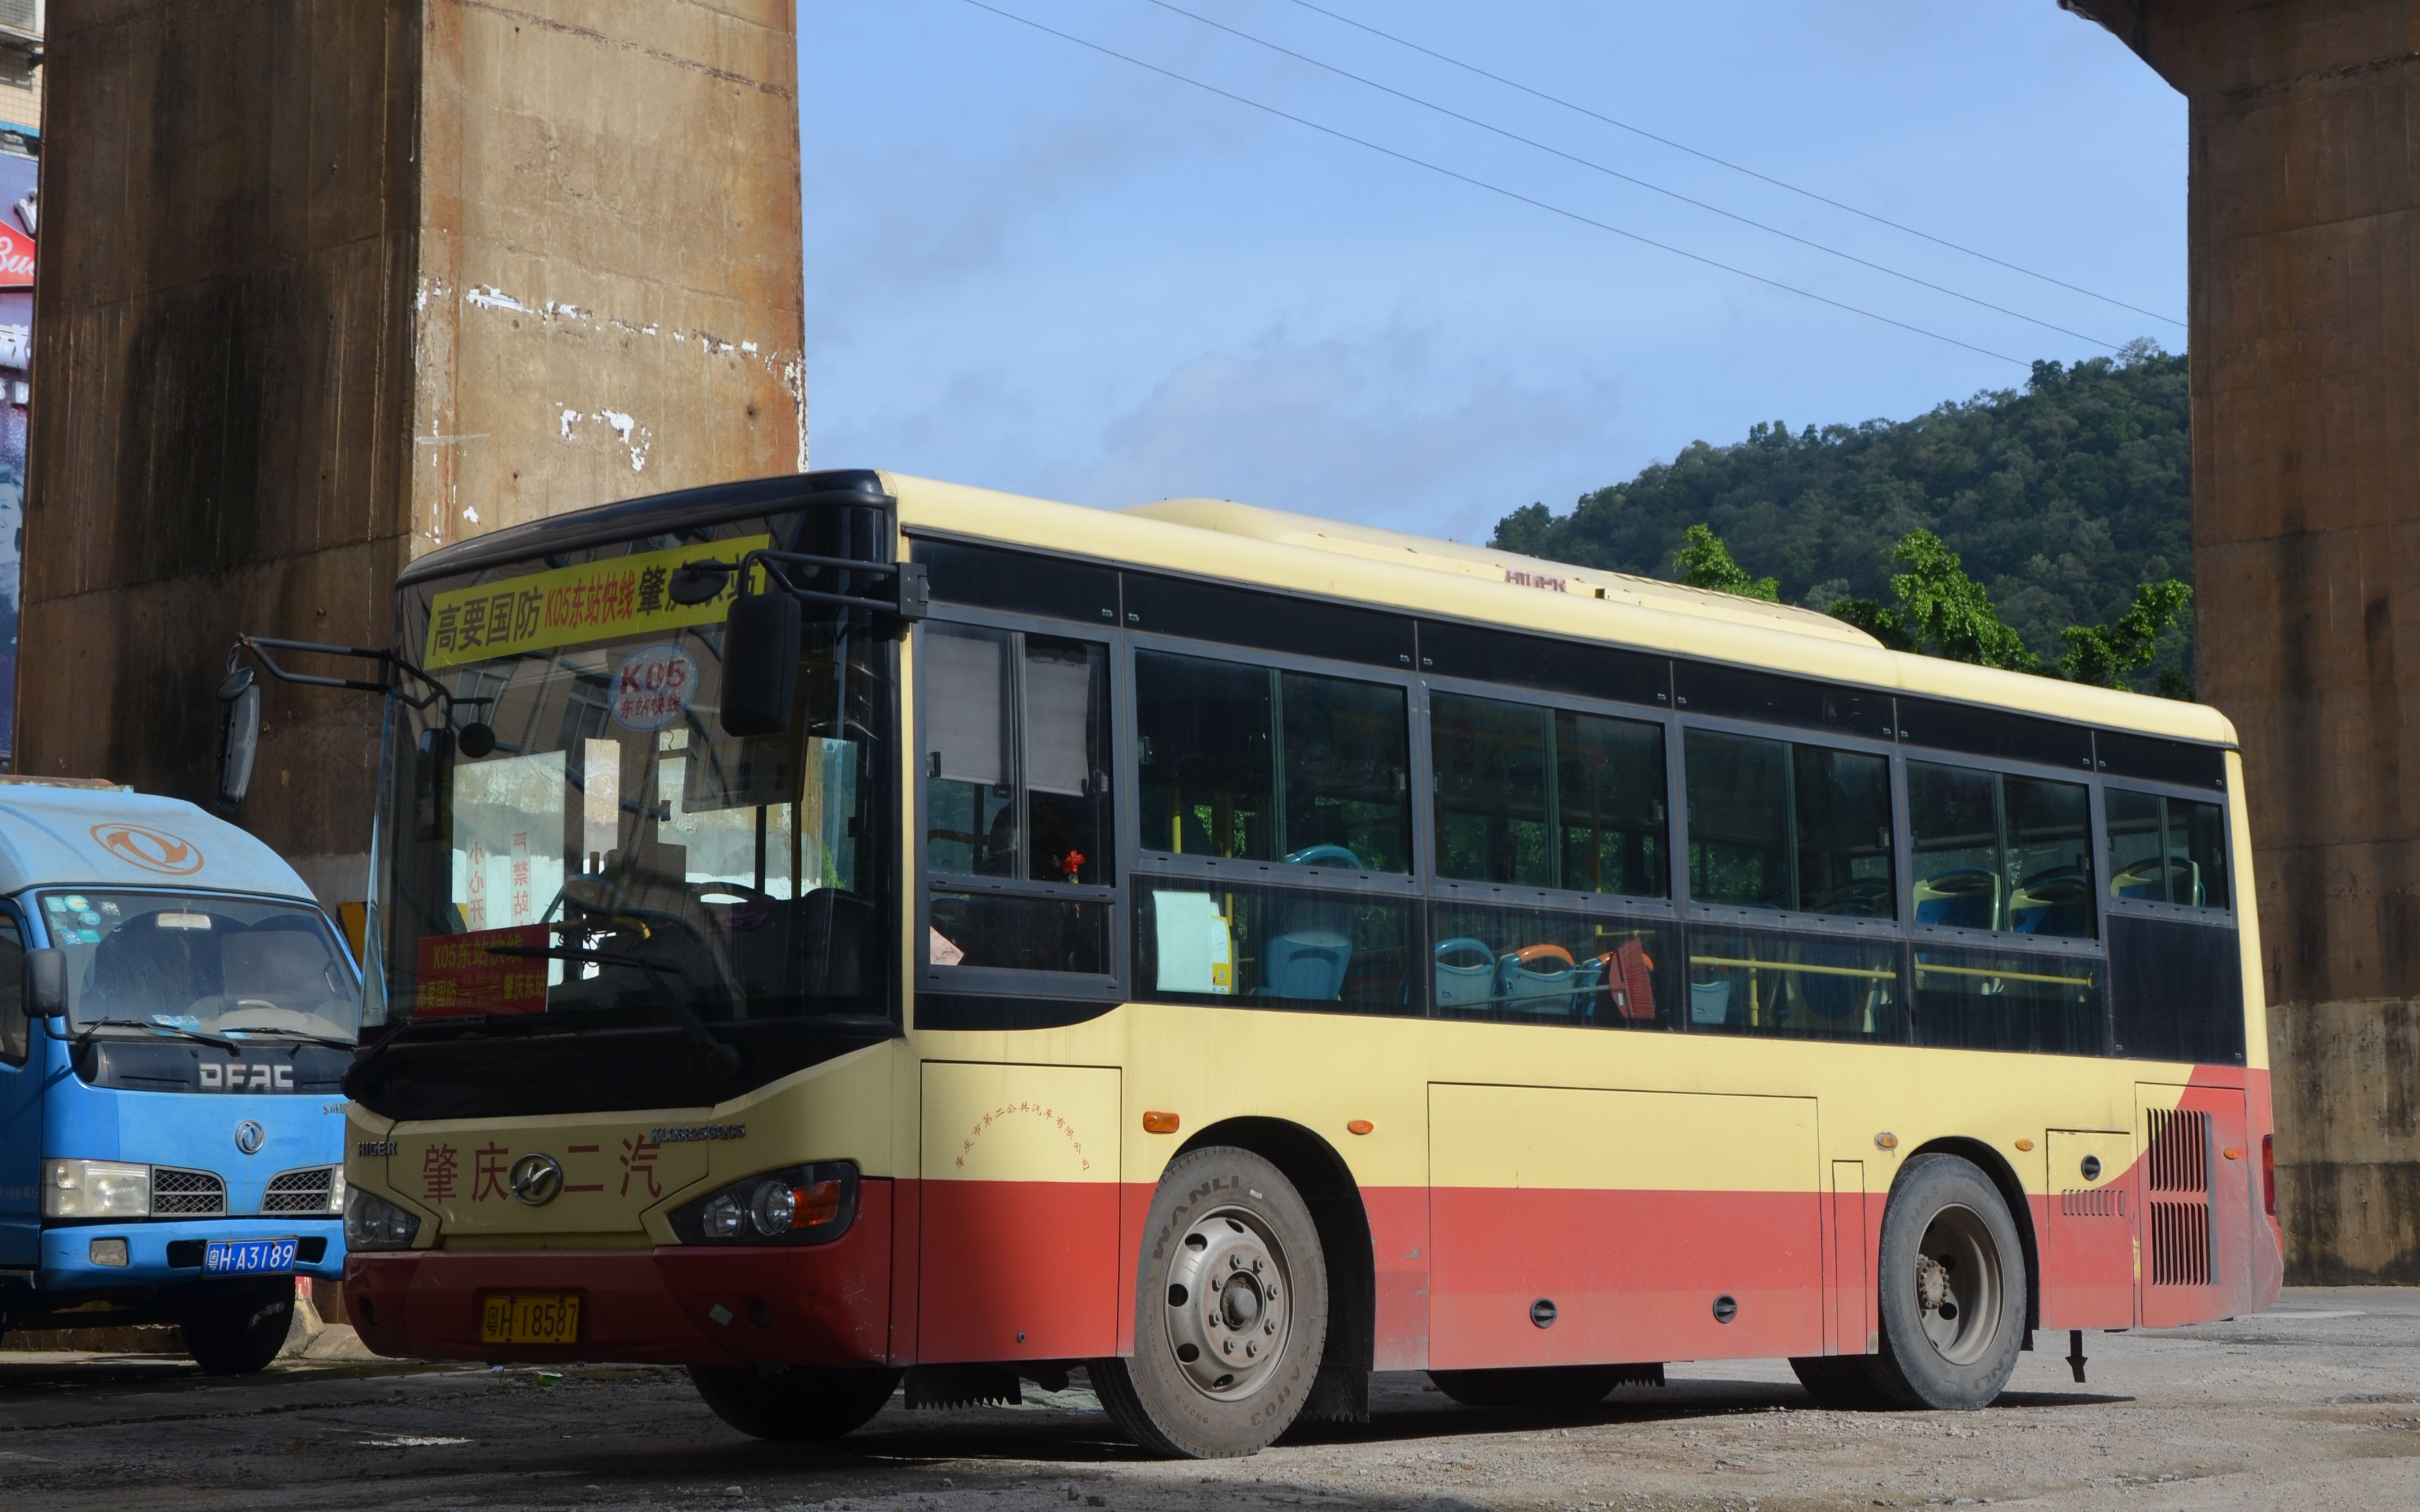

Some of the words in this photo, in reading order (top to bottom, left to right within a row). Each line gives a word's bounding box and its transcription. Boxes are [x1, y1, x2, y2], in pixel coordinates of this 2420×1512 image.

[432, 585, 543, 656] 高要国防
[544, 570, 635, 629] K05东站快线
[621, 659, 686, 694] K05
[621, 691, 681, 720] 东站快线
[417, 979, 458, 1010] 高要国防
[503, 969, 546, 1001] 肇庆东站
[199, 1063, 294, 1089] DFAC
[358, 1140, 398, 1157] HIGER
[1152, 1175, 1239, 1260] WANLI
